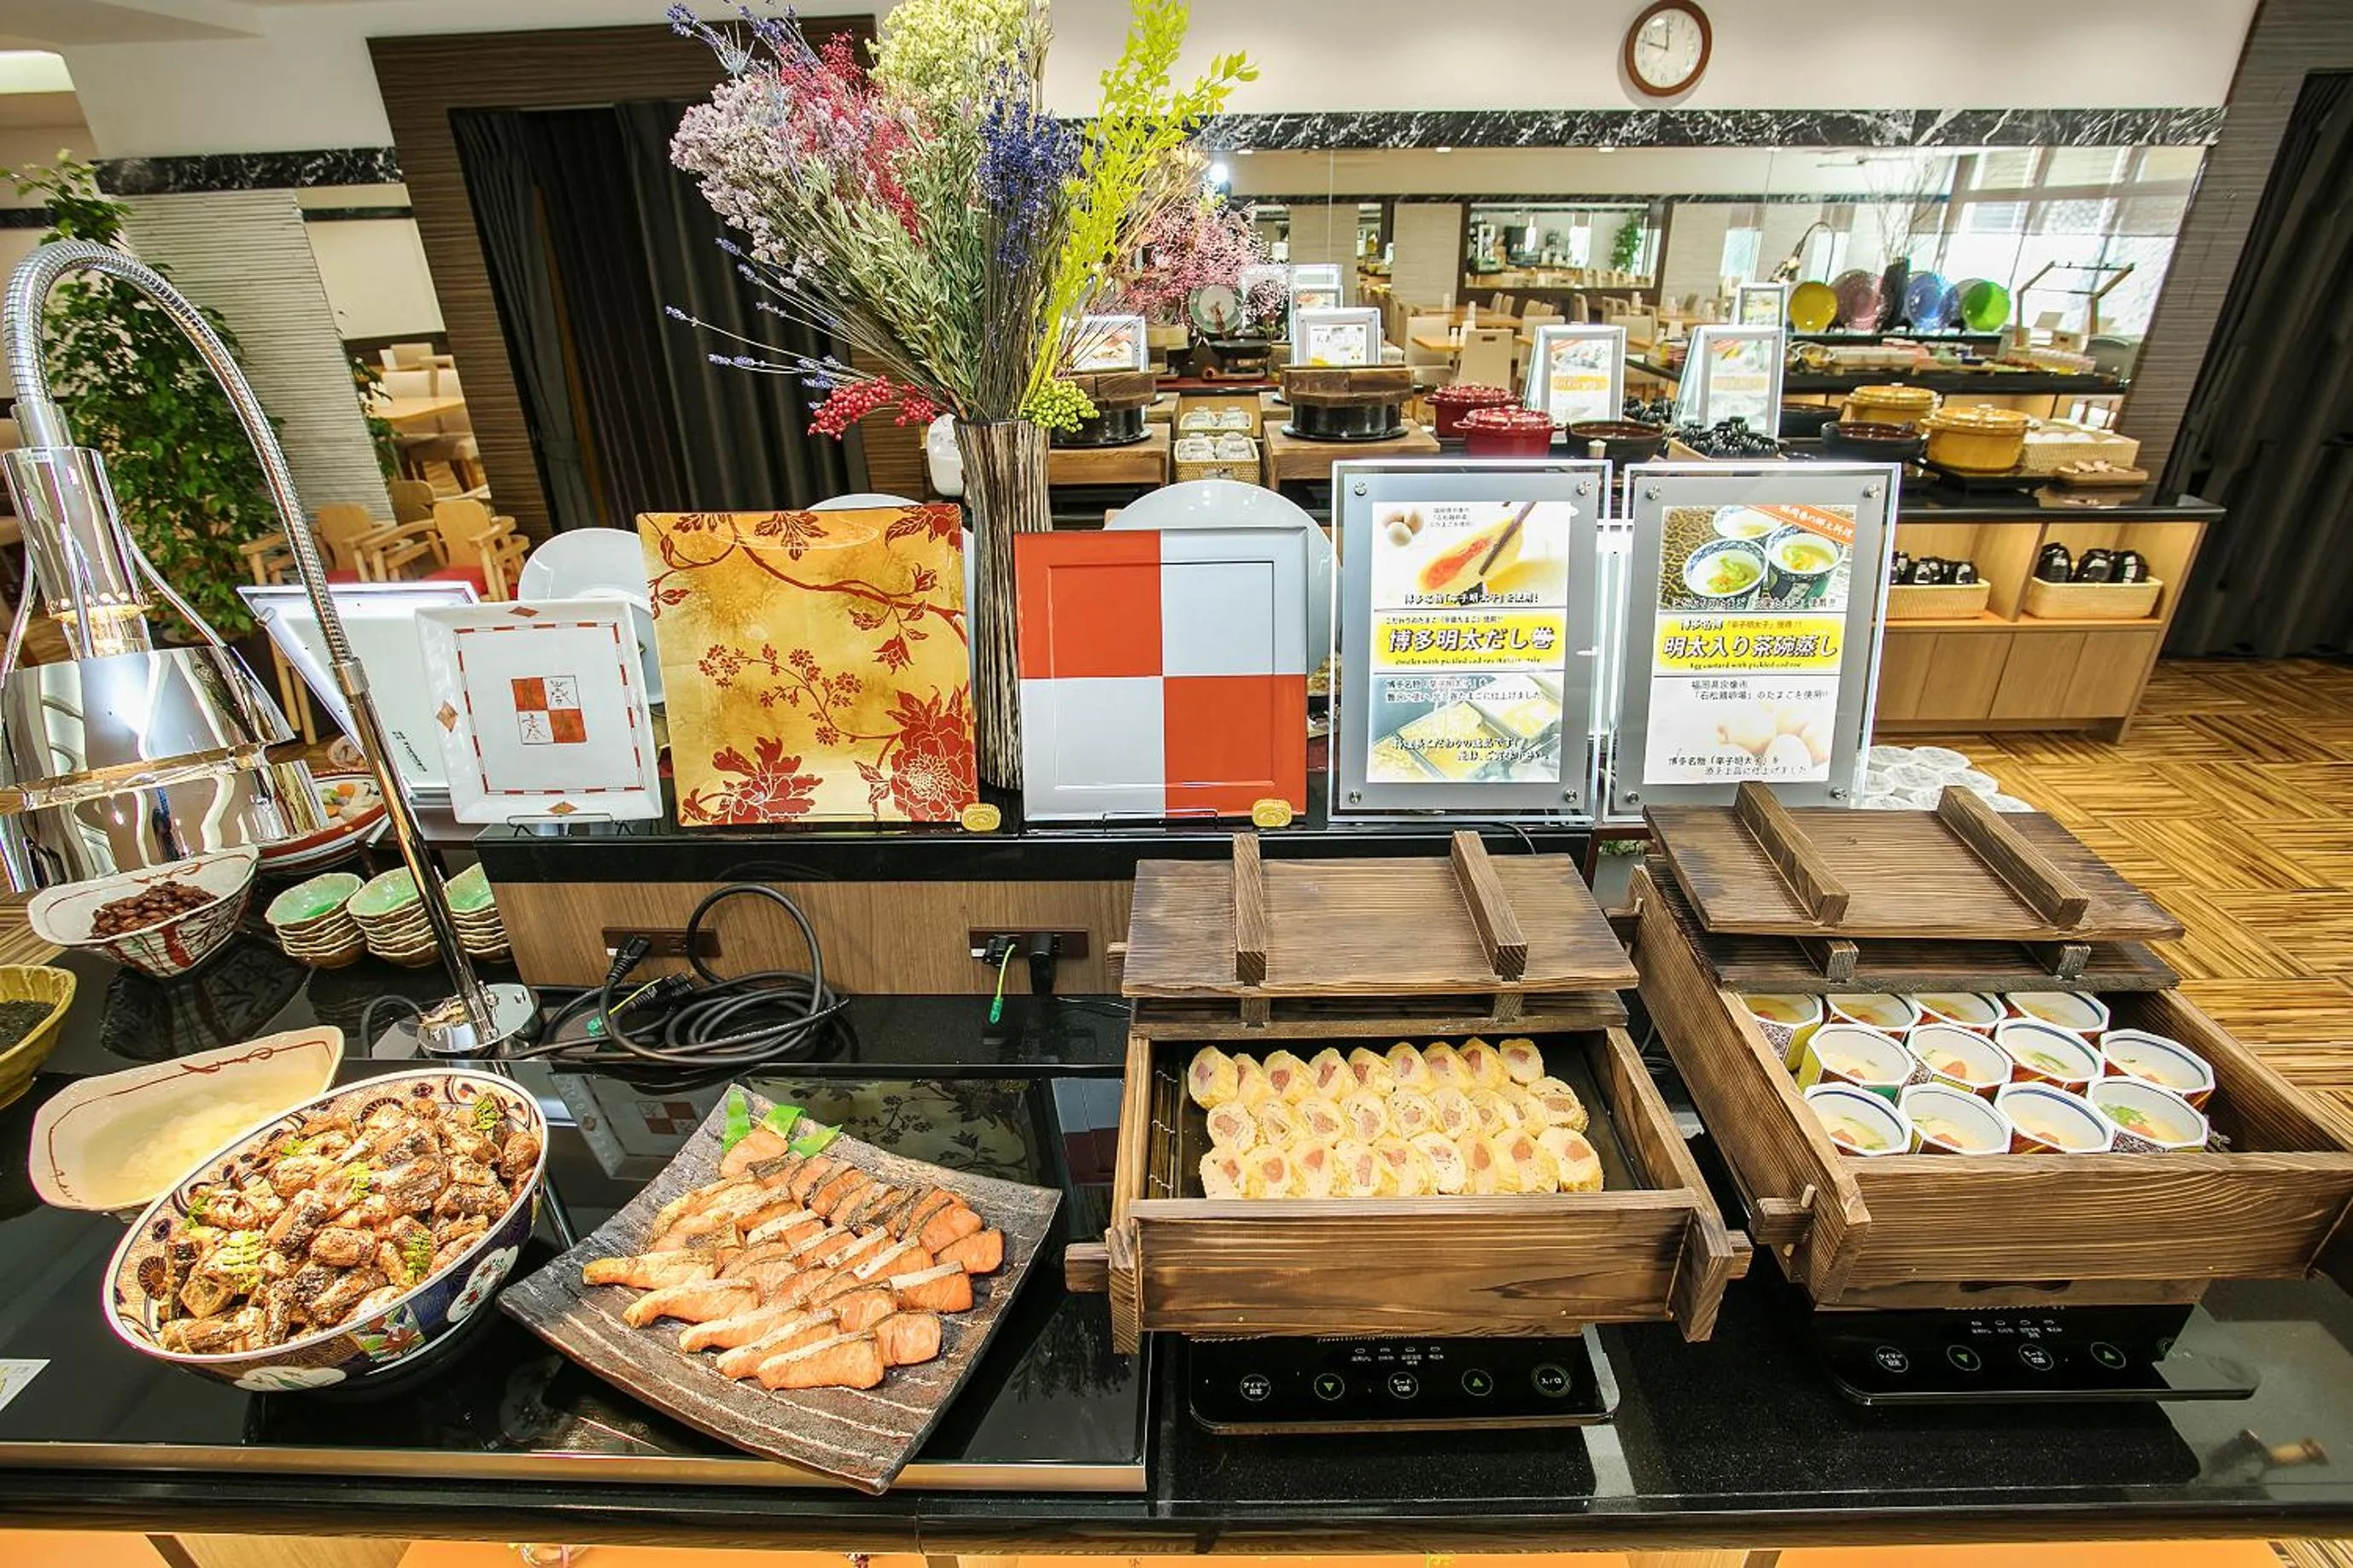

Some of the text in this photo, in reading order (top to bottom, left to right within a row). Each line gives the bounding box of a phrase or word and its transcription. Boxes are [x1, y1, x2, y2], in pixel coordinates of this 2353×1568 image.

[1388, 627, 1556, 653] 博多明太だし巻
[1663, 635, 1837, 659] 明太入り茶碗蒸し
